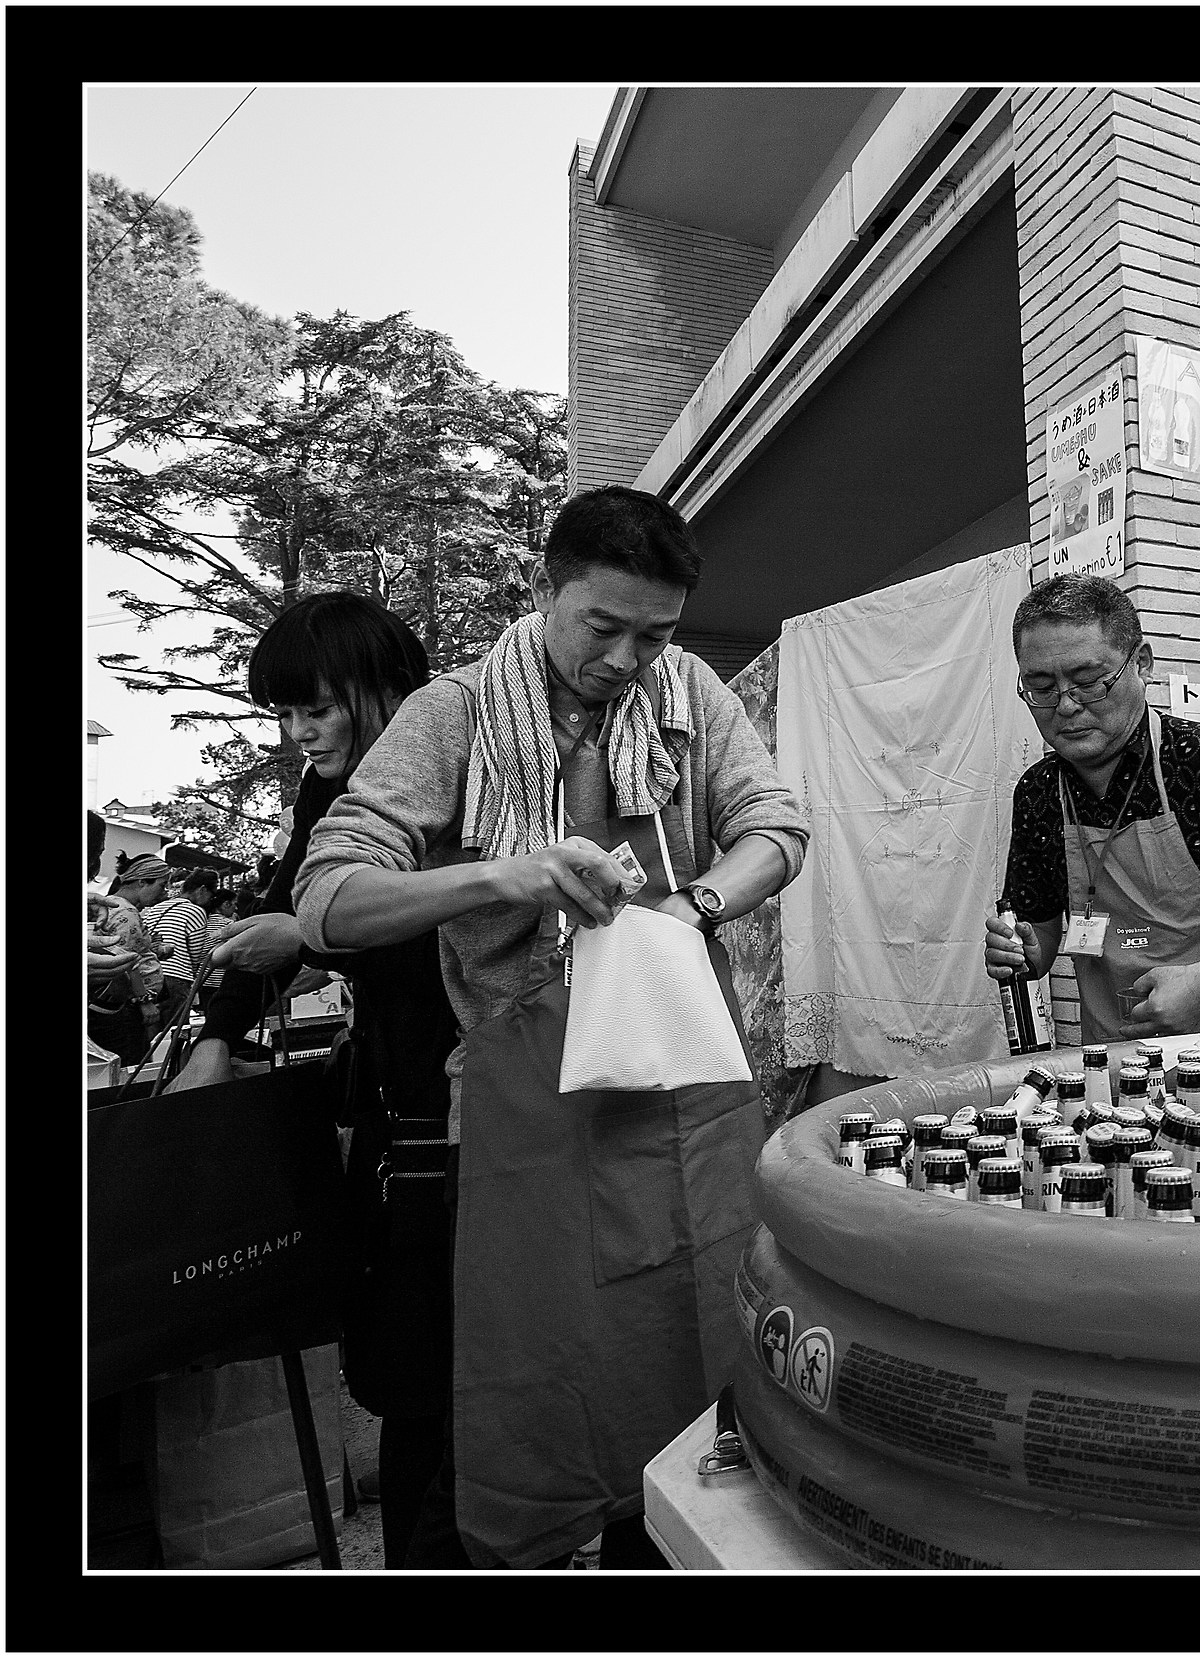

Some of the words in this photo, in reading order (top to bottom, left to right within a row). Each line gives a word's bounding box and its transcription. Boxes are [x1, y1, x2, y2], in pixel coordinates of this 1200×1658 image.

[1051, 422, 1098, 463] UMESHU
[1077, 448, 1091, 471] &
[1091, 453, 1122, 487] SAKE
[1053, 546, 1069, 566] UN
[1121, 937, 1149, 947] JCB
[172, 1230, 303, 1285] LONGCHAMP
[218, 1259, 263, 1279] PARIS
[868, 1519, 886, 1544] DES
[886, 1527, 928, 1563] ENFANTS
[928, 1545, 943, 1569] SE
